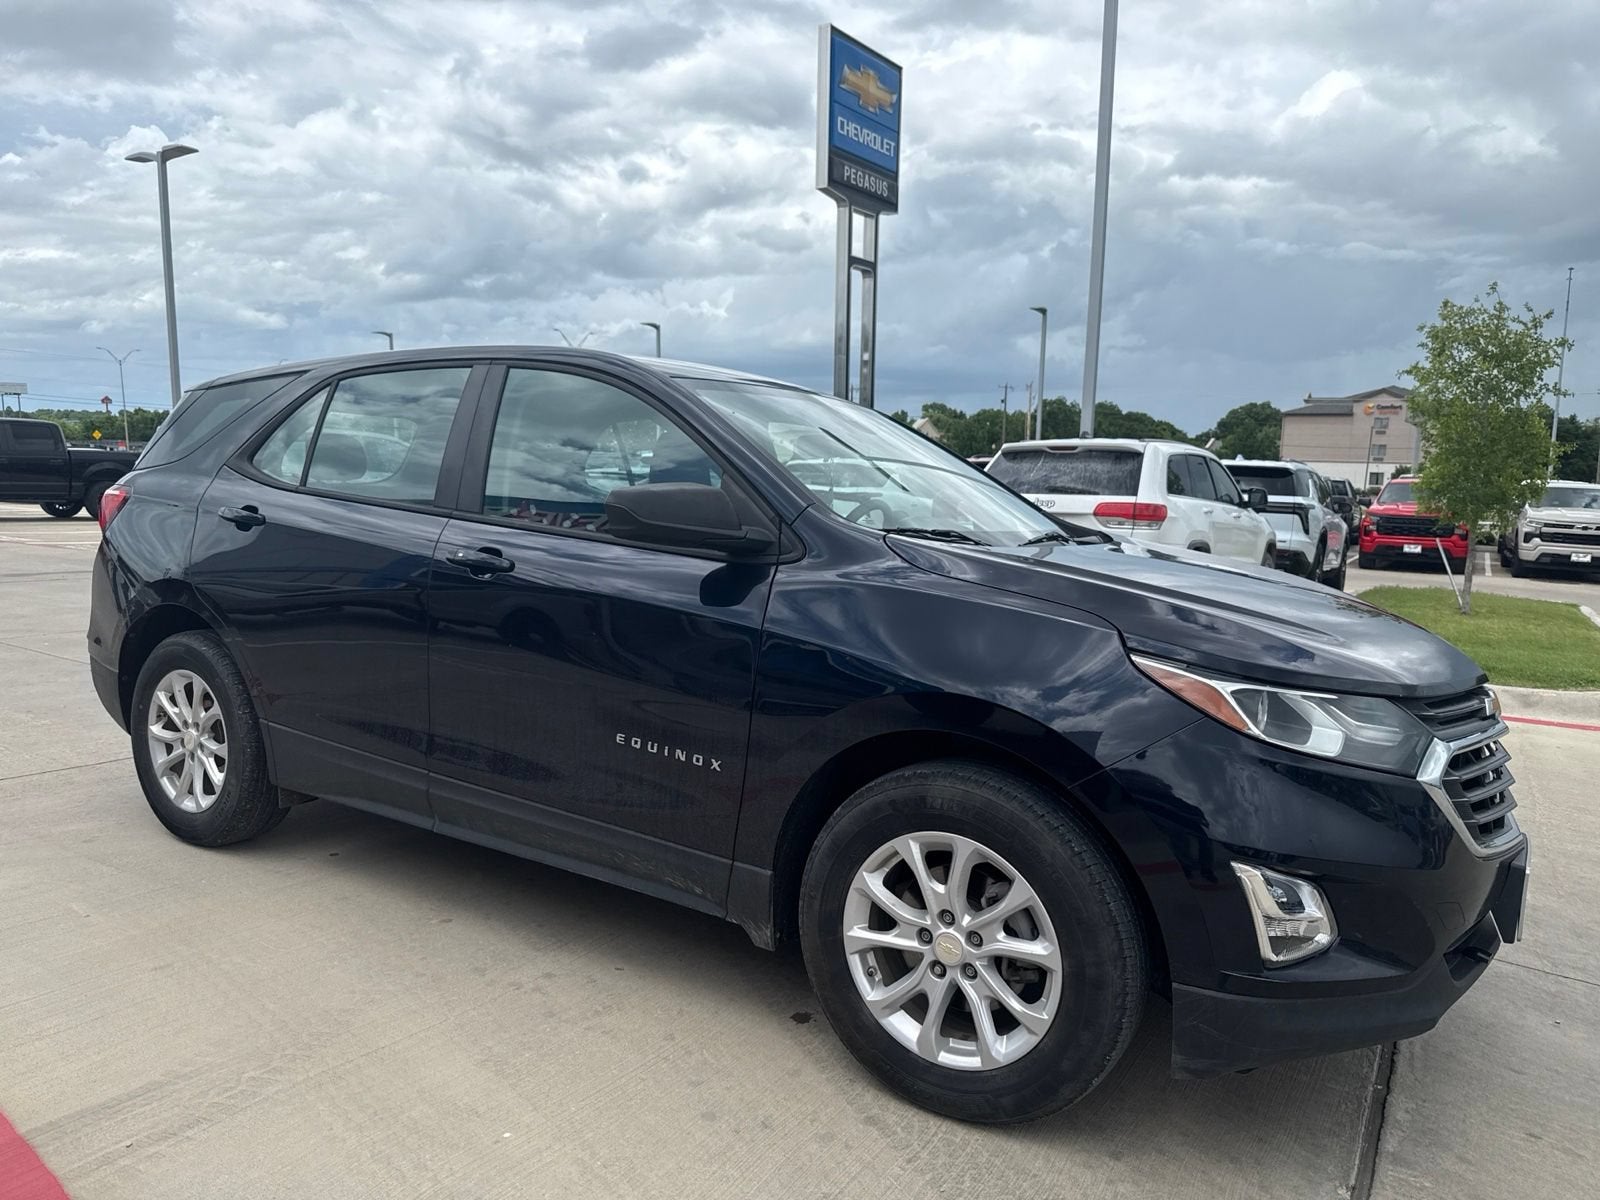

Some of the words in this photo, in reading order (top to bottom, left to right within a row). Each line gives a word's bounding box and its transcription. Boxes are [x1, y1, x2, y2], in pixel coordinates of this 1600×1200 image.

[837, 116, 896, 157] CHEVROLET
[844, 165, 889, 197] PEGASUS
[1034, 497, 1056, 509] Jeep
[616, 733, 722, 772] EQUINOX
